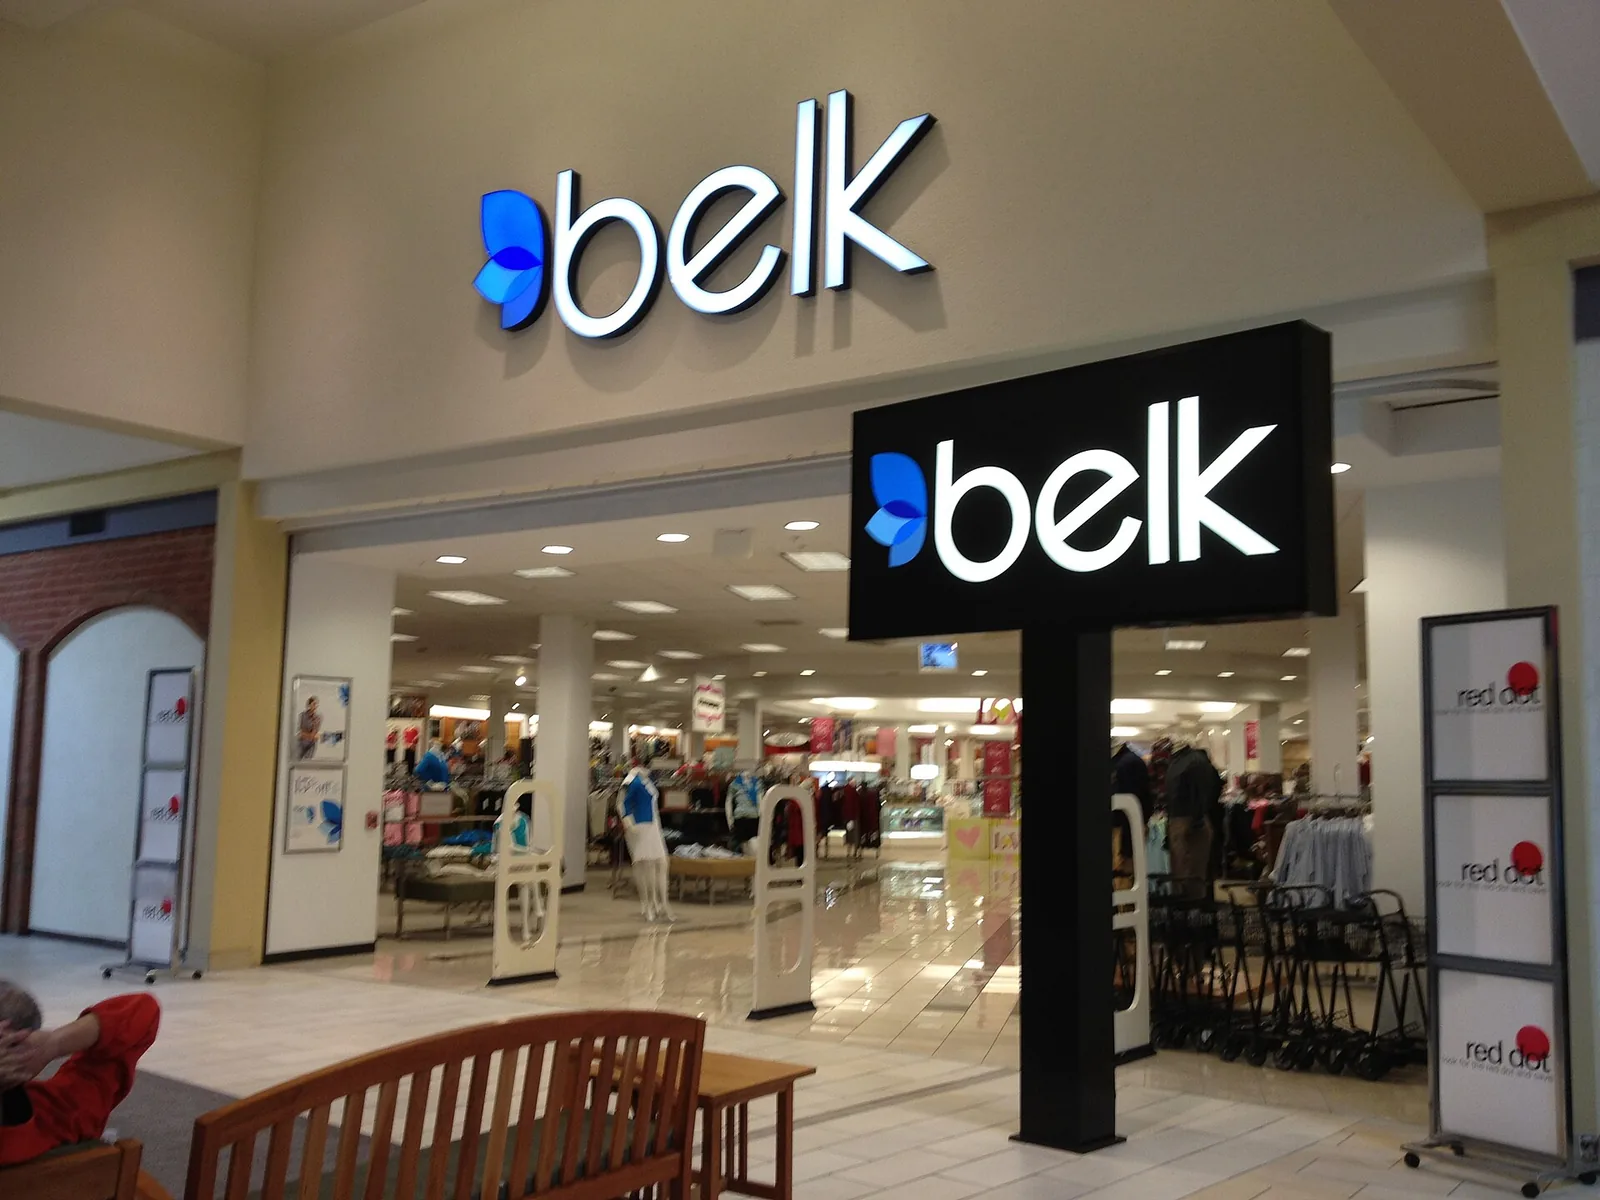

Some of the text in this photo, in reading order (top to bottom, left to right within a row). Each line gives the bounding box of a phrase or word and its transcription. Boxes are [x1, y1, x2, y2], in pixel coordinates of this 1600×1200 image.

[552, 88, 937, 339] belk
[934, 396, 1280, 582] belk
[1456, 678, 1541, 707] red dot
[1461, 858, 1544, 886] red dot
[1466, 1040, 1551, 1073] red dot
